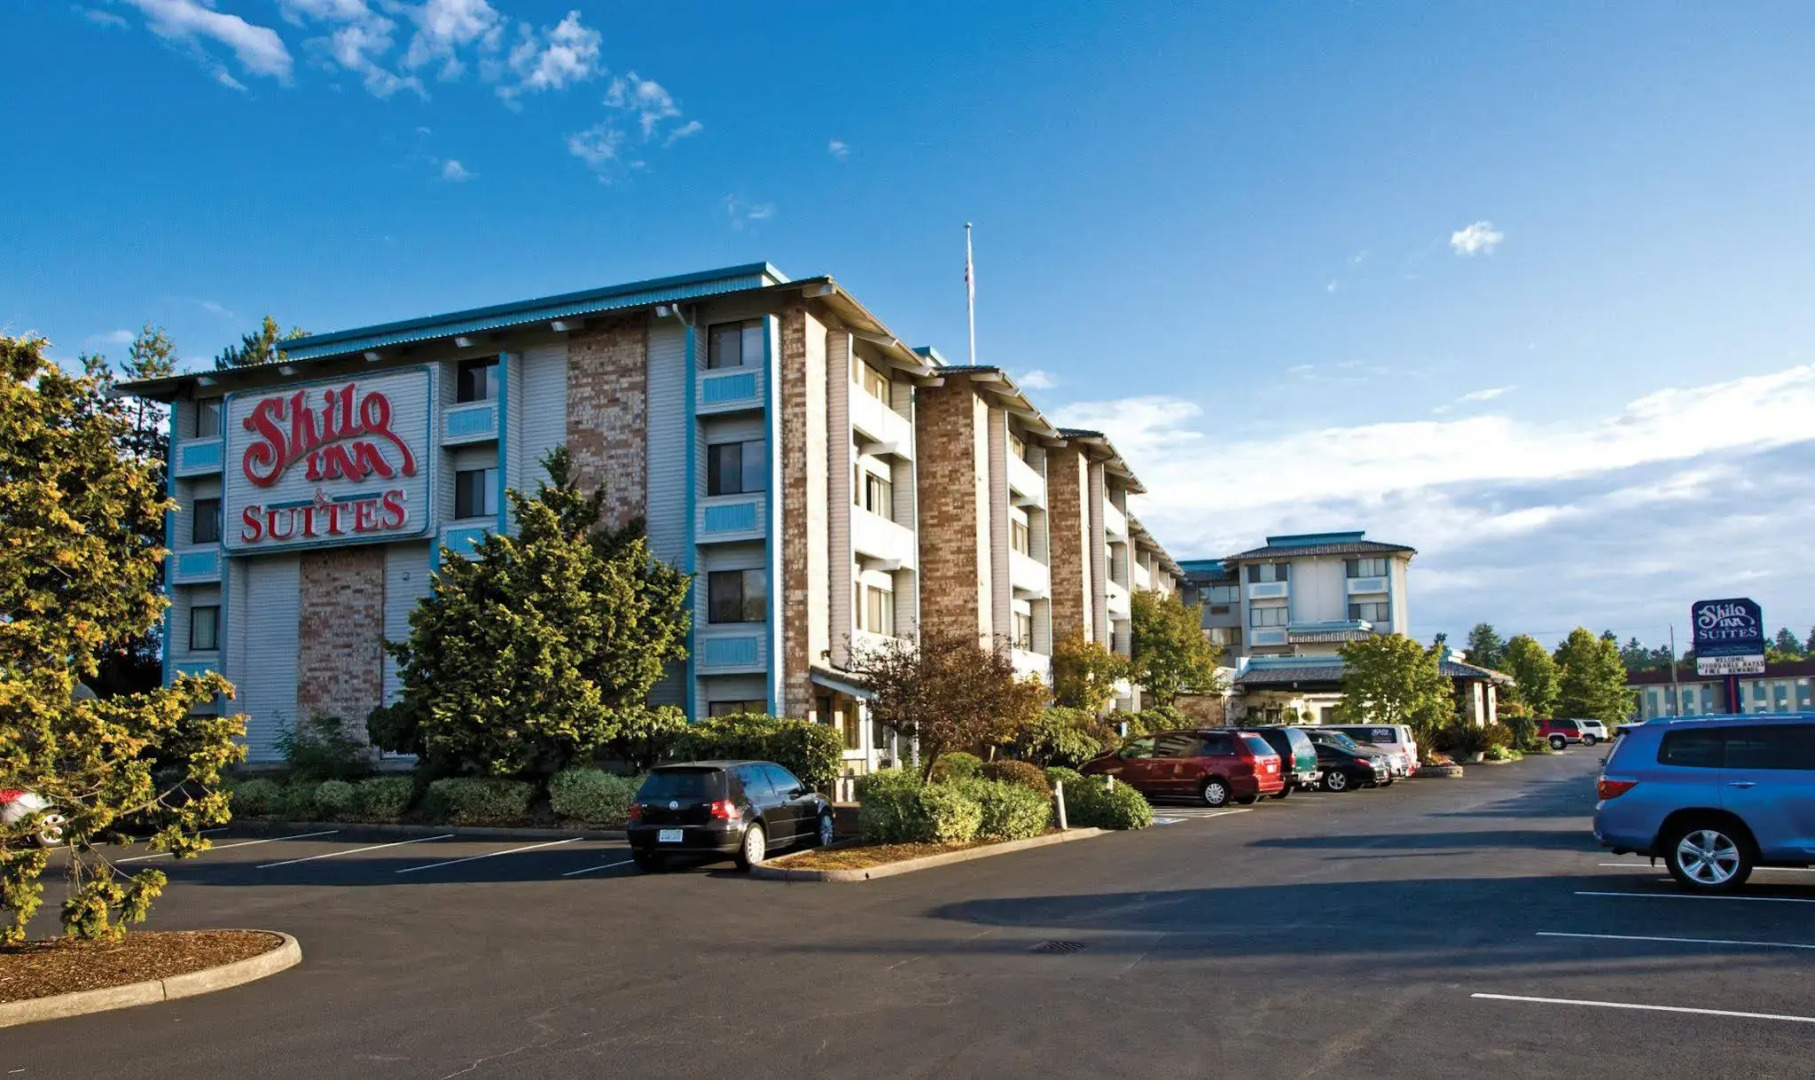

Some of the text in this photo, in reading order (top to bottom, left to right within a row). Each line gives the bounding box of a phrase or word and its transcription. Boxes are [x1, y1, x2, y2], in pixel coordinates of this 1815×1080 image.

[243, 382, 417, 488] Shilo
[241, 490, 407, 542] SUITES
[1698, 603, 1755, 629] Shilo
[1699, 626, 1758, 640] SUITES
